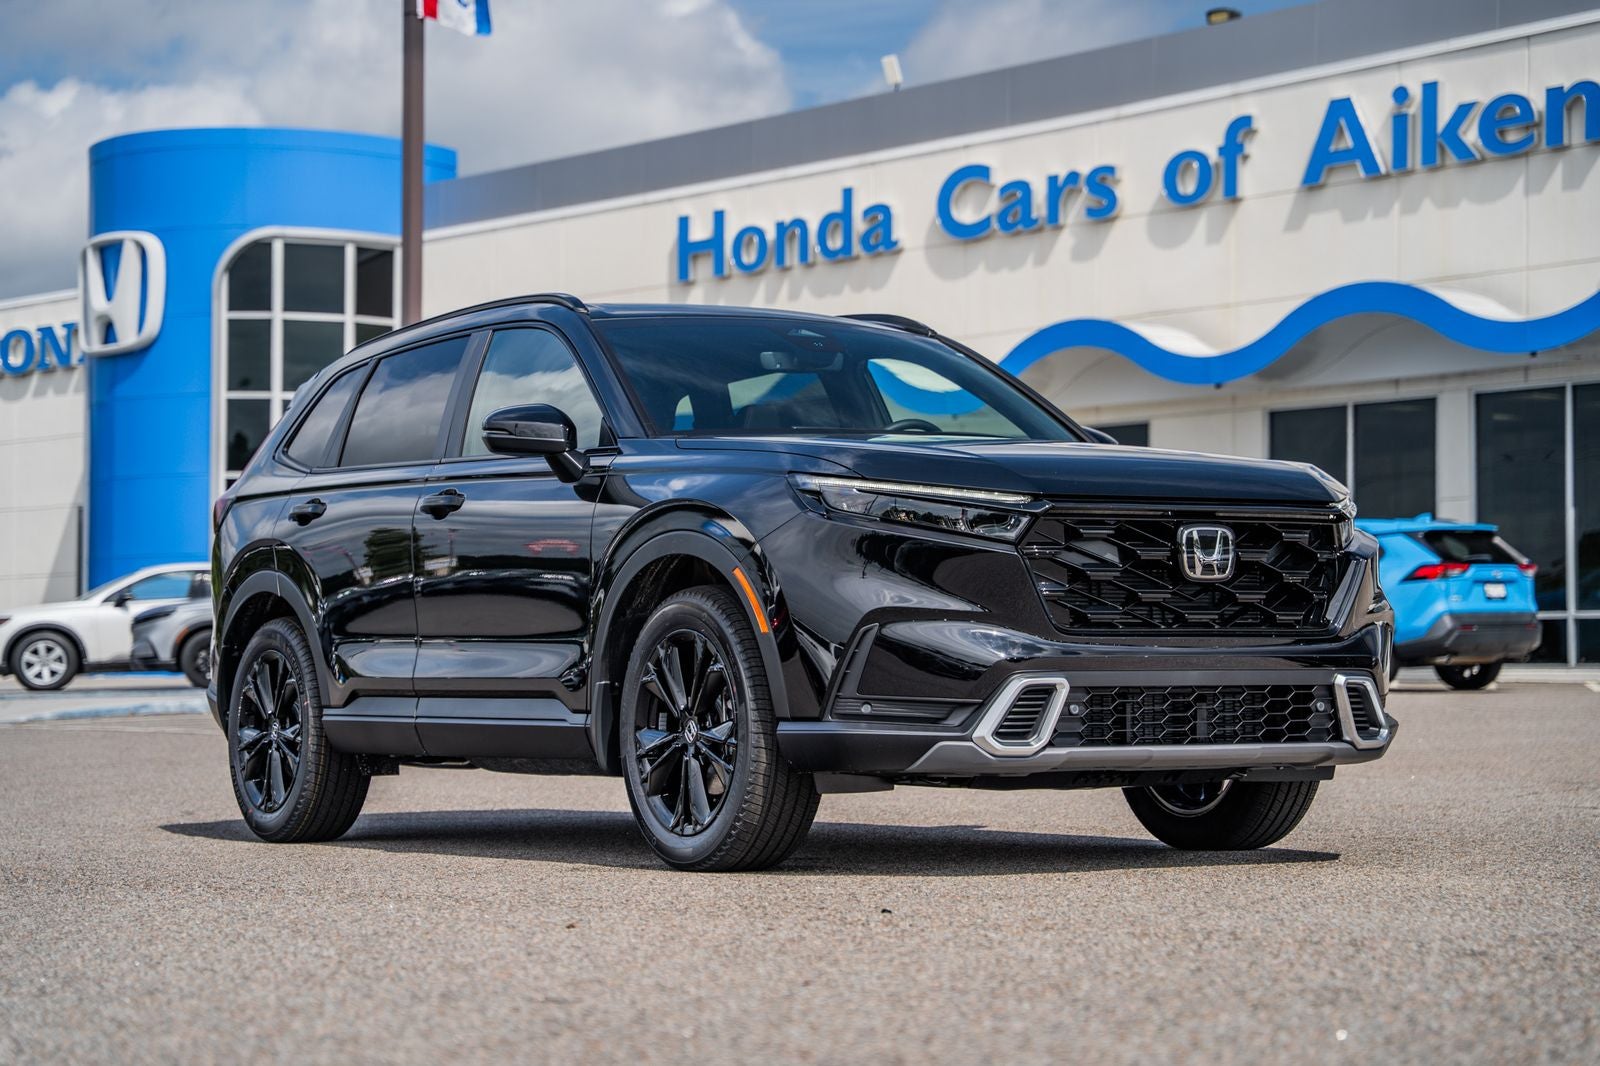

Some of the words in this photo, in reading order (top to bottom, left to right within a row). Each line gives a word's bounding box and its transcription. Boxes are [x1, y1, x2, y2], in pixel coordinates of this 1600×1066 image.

[677, 188, 899, 283] Honda
[937, 163, 1119, 241] Cars
[1162, 115, 1254, 206] of
[1301, 80, 1600, 187] Aiken
[0, 322, 84, 376] ON
